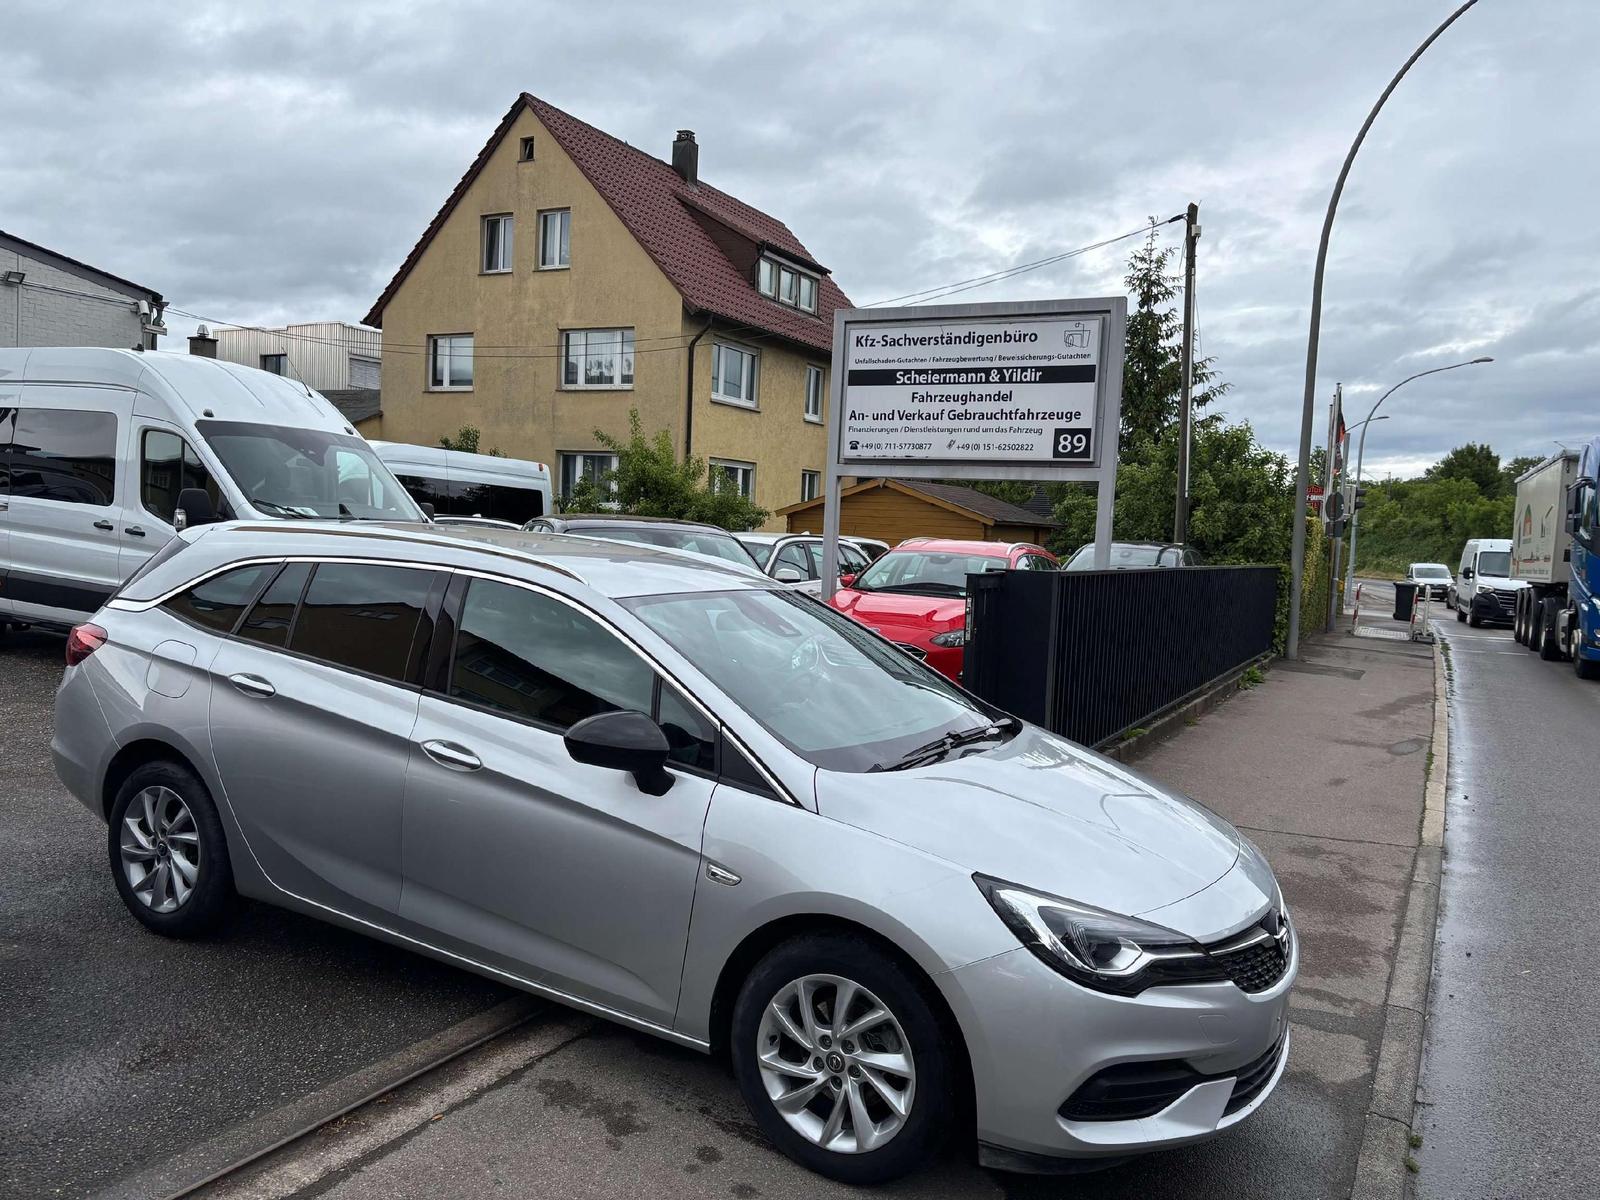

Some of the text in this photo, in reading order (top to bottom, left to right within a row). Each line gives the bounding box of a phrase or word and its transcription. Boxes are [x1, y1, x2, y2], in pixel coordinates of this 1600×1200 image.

[855, 330, 1038, 348] Kfz-Sachverständigenbüro
[998, 353, 1092, 361] Beweissicherungs-Gutachten
[896, 369, 1042, 384] Scheiermann & Yildir
[911, 391, 1013, 405] Fahrzeughandel
[849, 408, 1082, 422] An- und Verkauf Gebrauchtfahrzeuge
[848, 426, 899, 435] Finanzierungen
[904, 426, 962, 435] Dienstleistungen
[1009, 426, 1043, 435] Fahrzeug
[983, 443, 1034, 451] 151-62502822
[1058, 434, 1087, 453] 89
